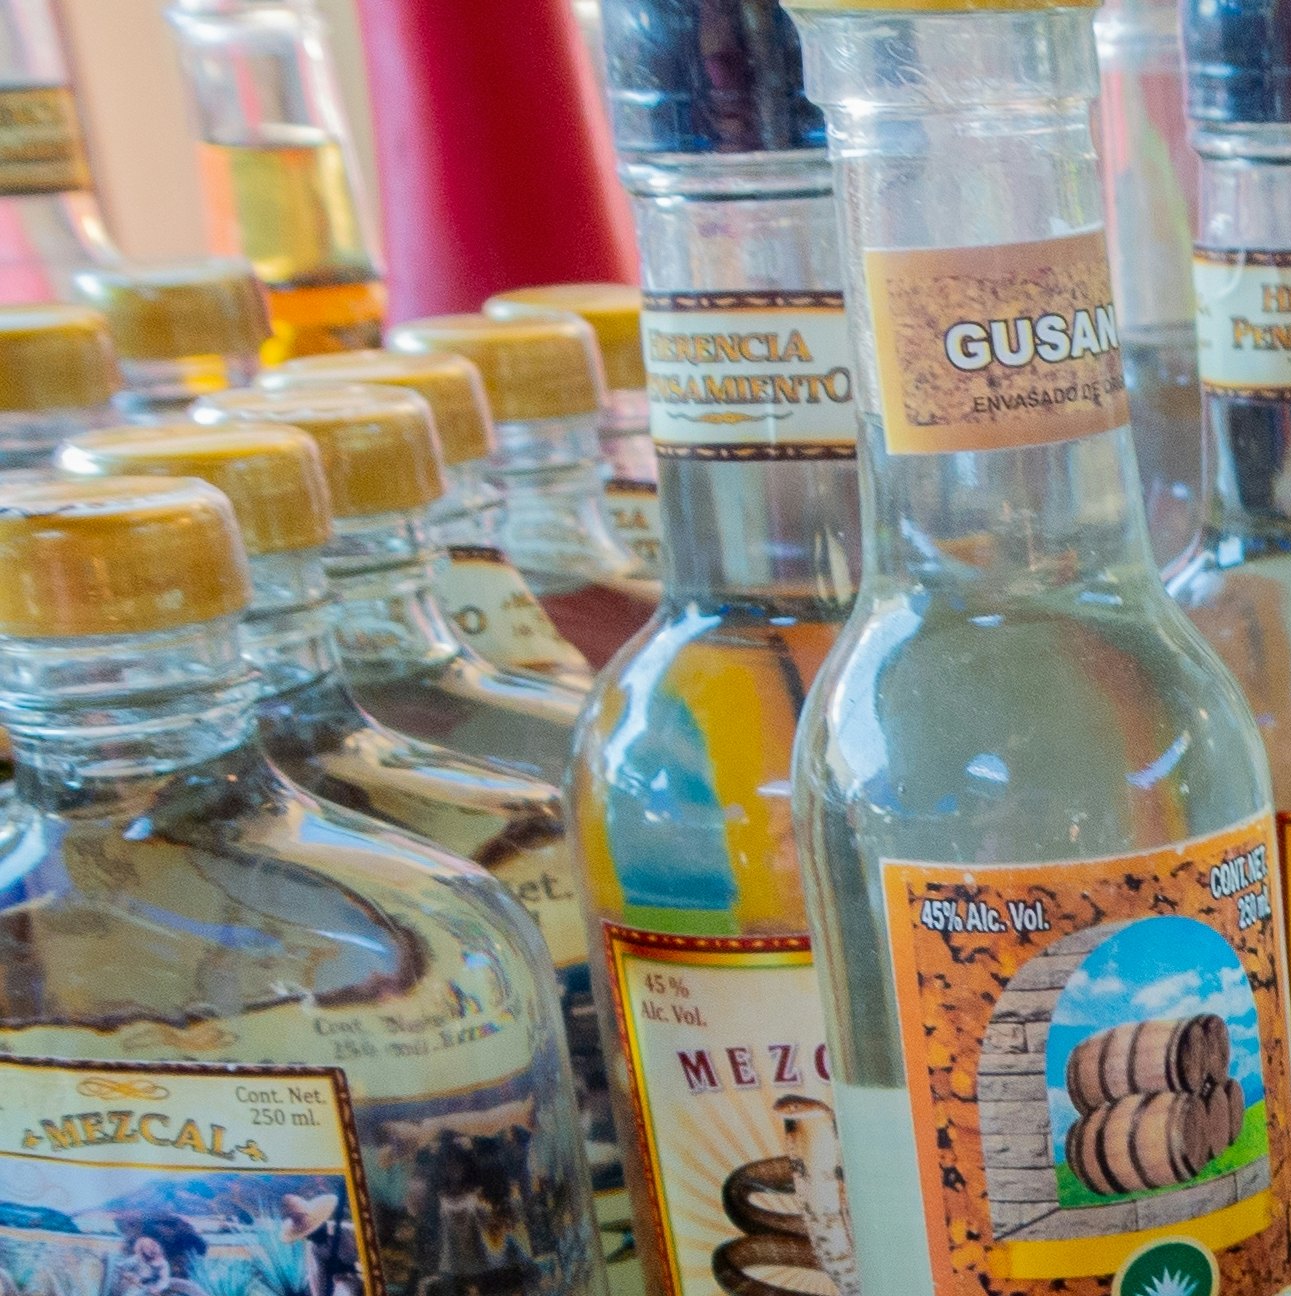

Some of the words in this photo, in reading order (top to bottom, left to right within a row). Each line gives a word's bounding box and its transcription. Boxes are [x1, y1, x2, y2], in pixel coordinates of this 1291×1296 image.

[921, 899, 963, 933] 45%
[967, 902, 1005, 932] Alc.
[1009, 901, 1051, 932] Vol.
[644, 973, 667, 995] 45
[669, 977, 690, 998] %
[641, 1000, 669, 1022] Alc.
[673, 1005, 707, 1027] Vol.
[235, 1085, 285, 1105] Cont.
[289, 1085, 326, 1105] Net.
[250, 1109, 285, 1126] 250
[291, 1109, 321, 1127] ml.
[41, 1110, 237, 1162] MEZCAL
